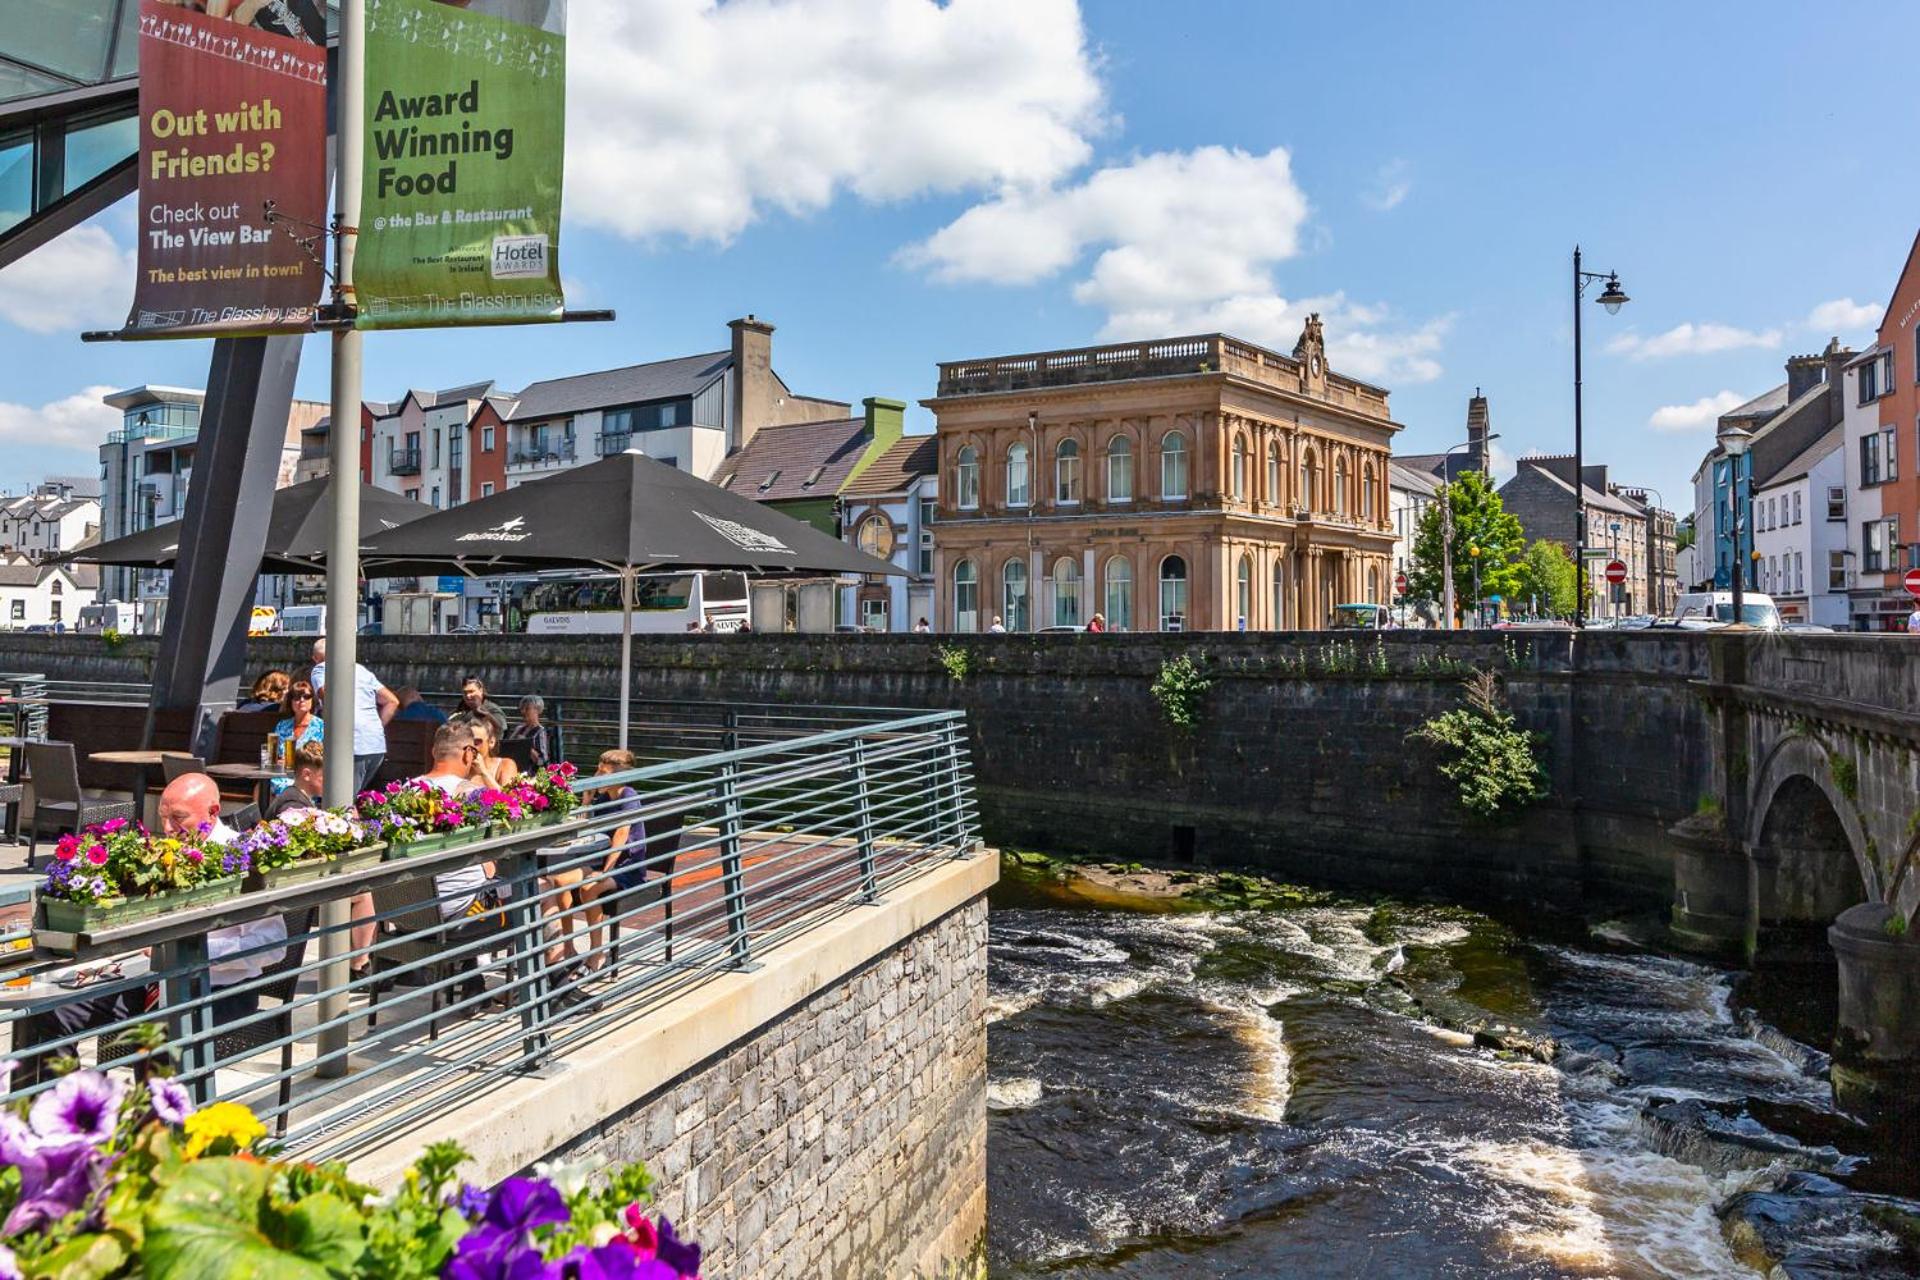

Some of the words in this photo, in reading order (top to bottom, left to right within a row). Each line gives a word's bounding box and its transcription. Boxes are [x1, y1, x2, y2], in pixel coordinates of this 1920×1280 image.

[374, 80, 479, 122] Award
[151, 109, 207, 138] Out
[215, 99, 282, 133] with
[374, 120, 513, 161] Winning
[151, 141, 275, 180] Friends?
[378, 160, 456, 199] Food
[150, 202, 204, 224] Check
[209, 203, 240, 220] out
[374, 216, 387, 230] @
[390, 213, 411, 227] the
[416, 211, 438, 226] Bar
[441, 210, 451, 224] &
[455, 207, 533, 223] Restaurant
[149, 230, 185, 249] The
[189, 227, 235, 247] View
[240, 225, 272, 244] Bar
[427, 256, 443, 264] Best
[445, 255, 484, 263] Restaurant
[496, 243, 543, 261] Hotel
[149, 269, 175, 284] The
[178, 267, 207, 282] best
[210, 265, 243, 280] view
[246, 263, 260, 278] in
[263, 261, 303, 278] town!
[458, 265, 484, 273] Ireland
[495, 260, 543, 269] AWARDS
[190, 308, 217, 324] The
[219, 303, 309, 323] Glasshouse
